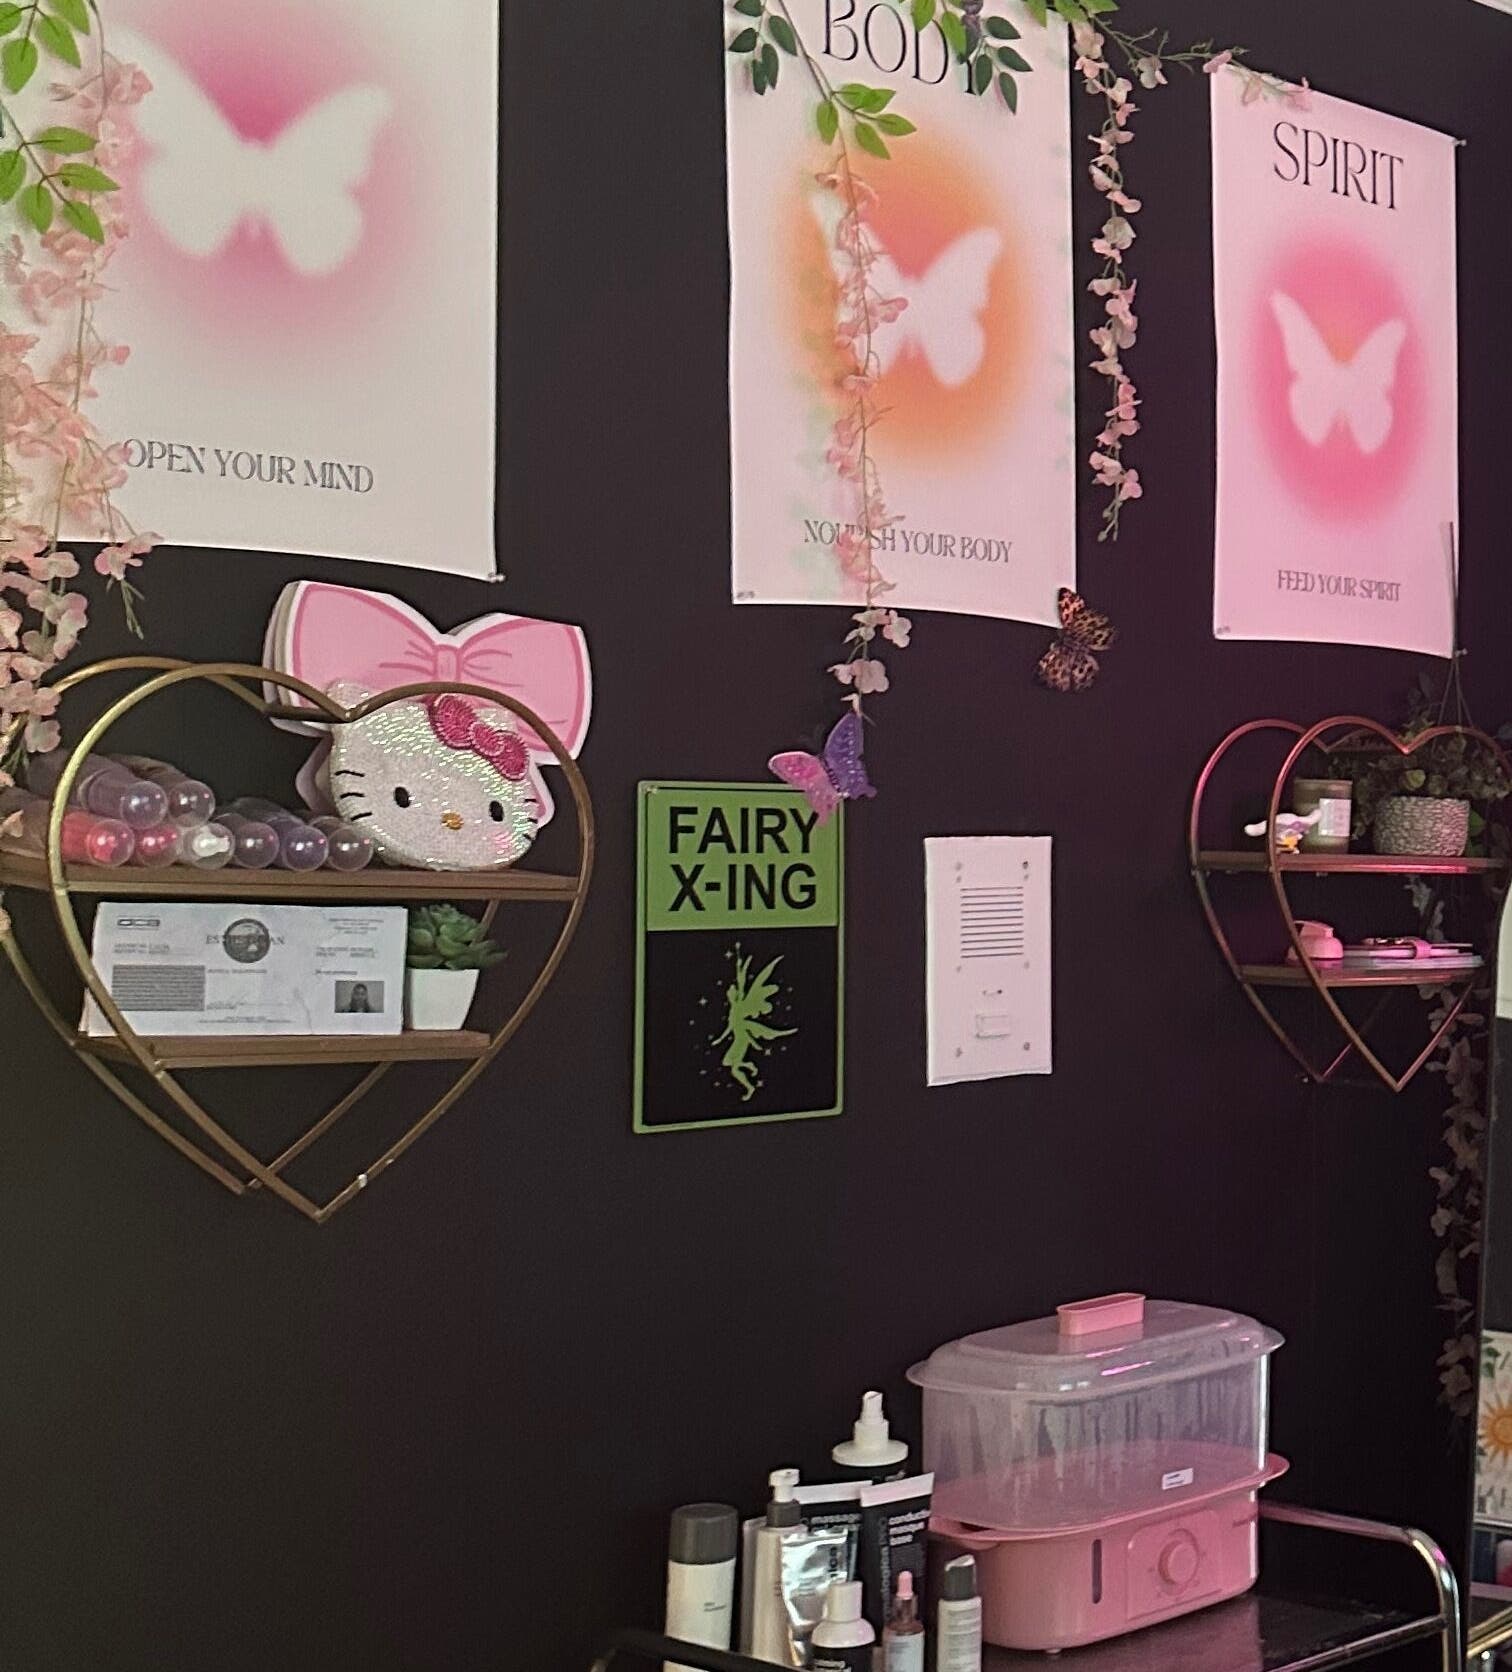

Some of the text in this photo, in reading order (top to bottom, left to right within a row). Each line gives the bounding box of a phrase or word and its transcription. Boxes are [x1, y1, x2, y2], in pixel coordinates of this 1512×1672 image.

[1273, 121, 1404, 209] SPIRIT
[123, 438, 374, 493] OPEN YOUR MIND
[900, 529, 956, 558] YOUR
[960, 536, 1013, 563] BODY
[1278, 569, 1402, 602] FEED YOUR SPIRIT
[668, 806, 819, 854] FAIRY
[668, 863, 817, 911] X-ING
